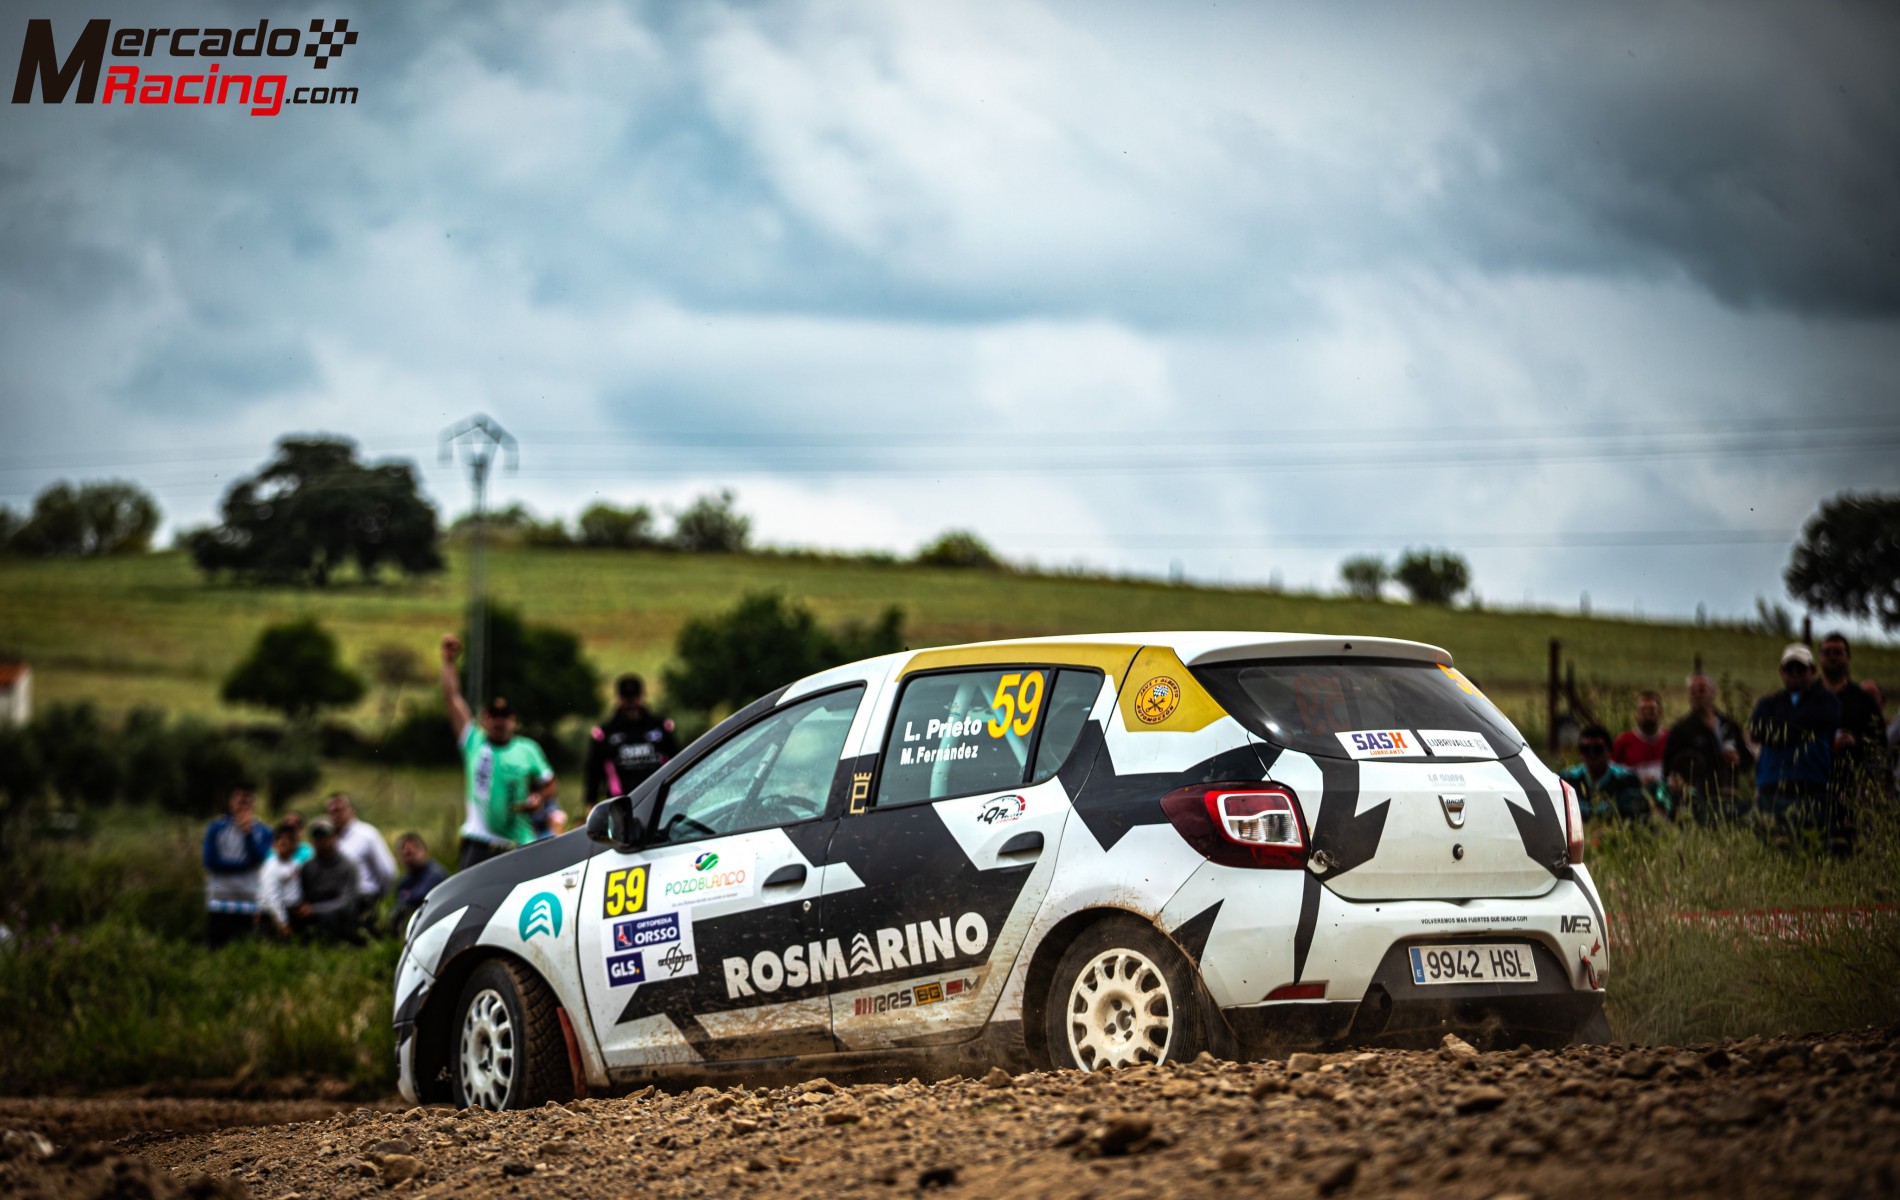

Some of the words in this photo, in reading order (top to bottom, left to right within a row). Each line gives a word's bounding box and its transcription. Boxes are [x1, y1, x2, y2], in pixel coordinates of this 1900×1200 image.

[1160, 679, 1179, 698] ALBERTO
[987, 670, 1044, 739] 59
[904, 721, 920, 742] L.
[926, 716, 982, 740] Prieto
[1351, 731, 1408, 750] SASH
[900, 747, 914, 765] M.
[916, 742, 978, 764] Fernández
[1426, 738, 1475, 748] LUBRIVALLE
[606, 867, 646, 917] 59
[665, 870, 746, 896] POZOBLANCO
[1501, 915, 1516, 923] NUNCA
[634, 926, 678, 945] ORSSO
[722, 911, 989, 999] ROSMARINO
[1427, 950, 1483, 978] 9942
[1490, 949, 1530, 977] HSL
[1417, 968, 1422, 977] E
[874, 989, 912, 1013] RRS
